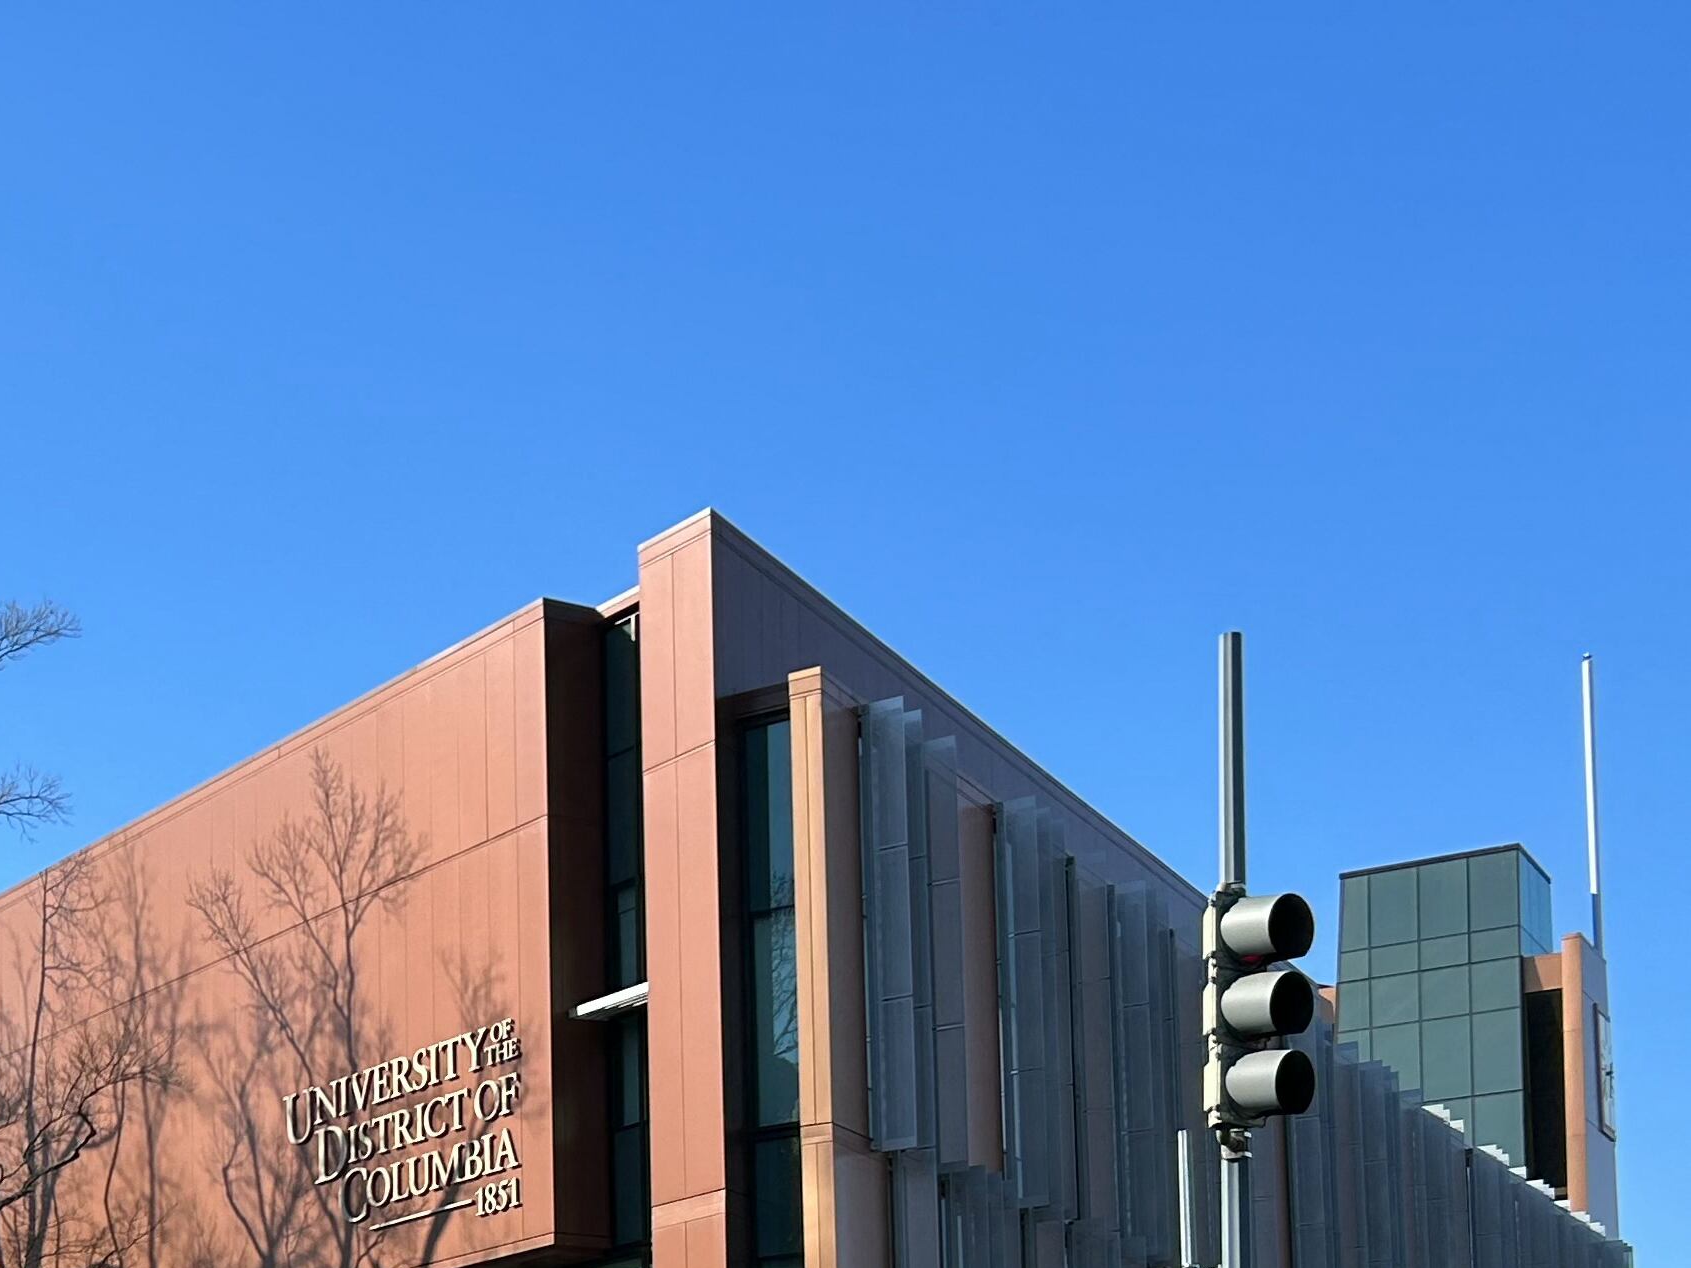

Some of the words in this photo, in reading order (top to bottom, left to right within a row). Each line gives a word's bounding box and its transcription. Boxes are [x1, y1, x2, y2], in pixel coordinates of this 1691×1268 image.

[489, 1017, 514, 1044] OF
[282, 1027, 487, 1145] UNIVERSITY
[484, 1037, 519, 1067] THE
[314, 1087, 469, 1185] DISTRICT
[473, 1071, 519, 1122] OF
[340, 1127, 519, 1223] COLUMBIA
[474, 1177, 520, 1217] 1851
